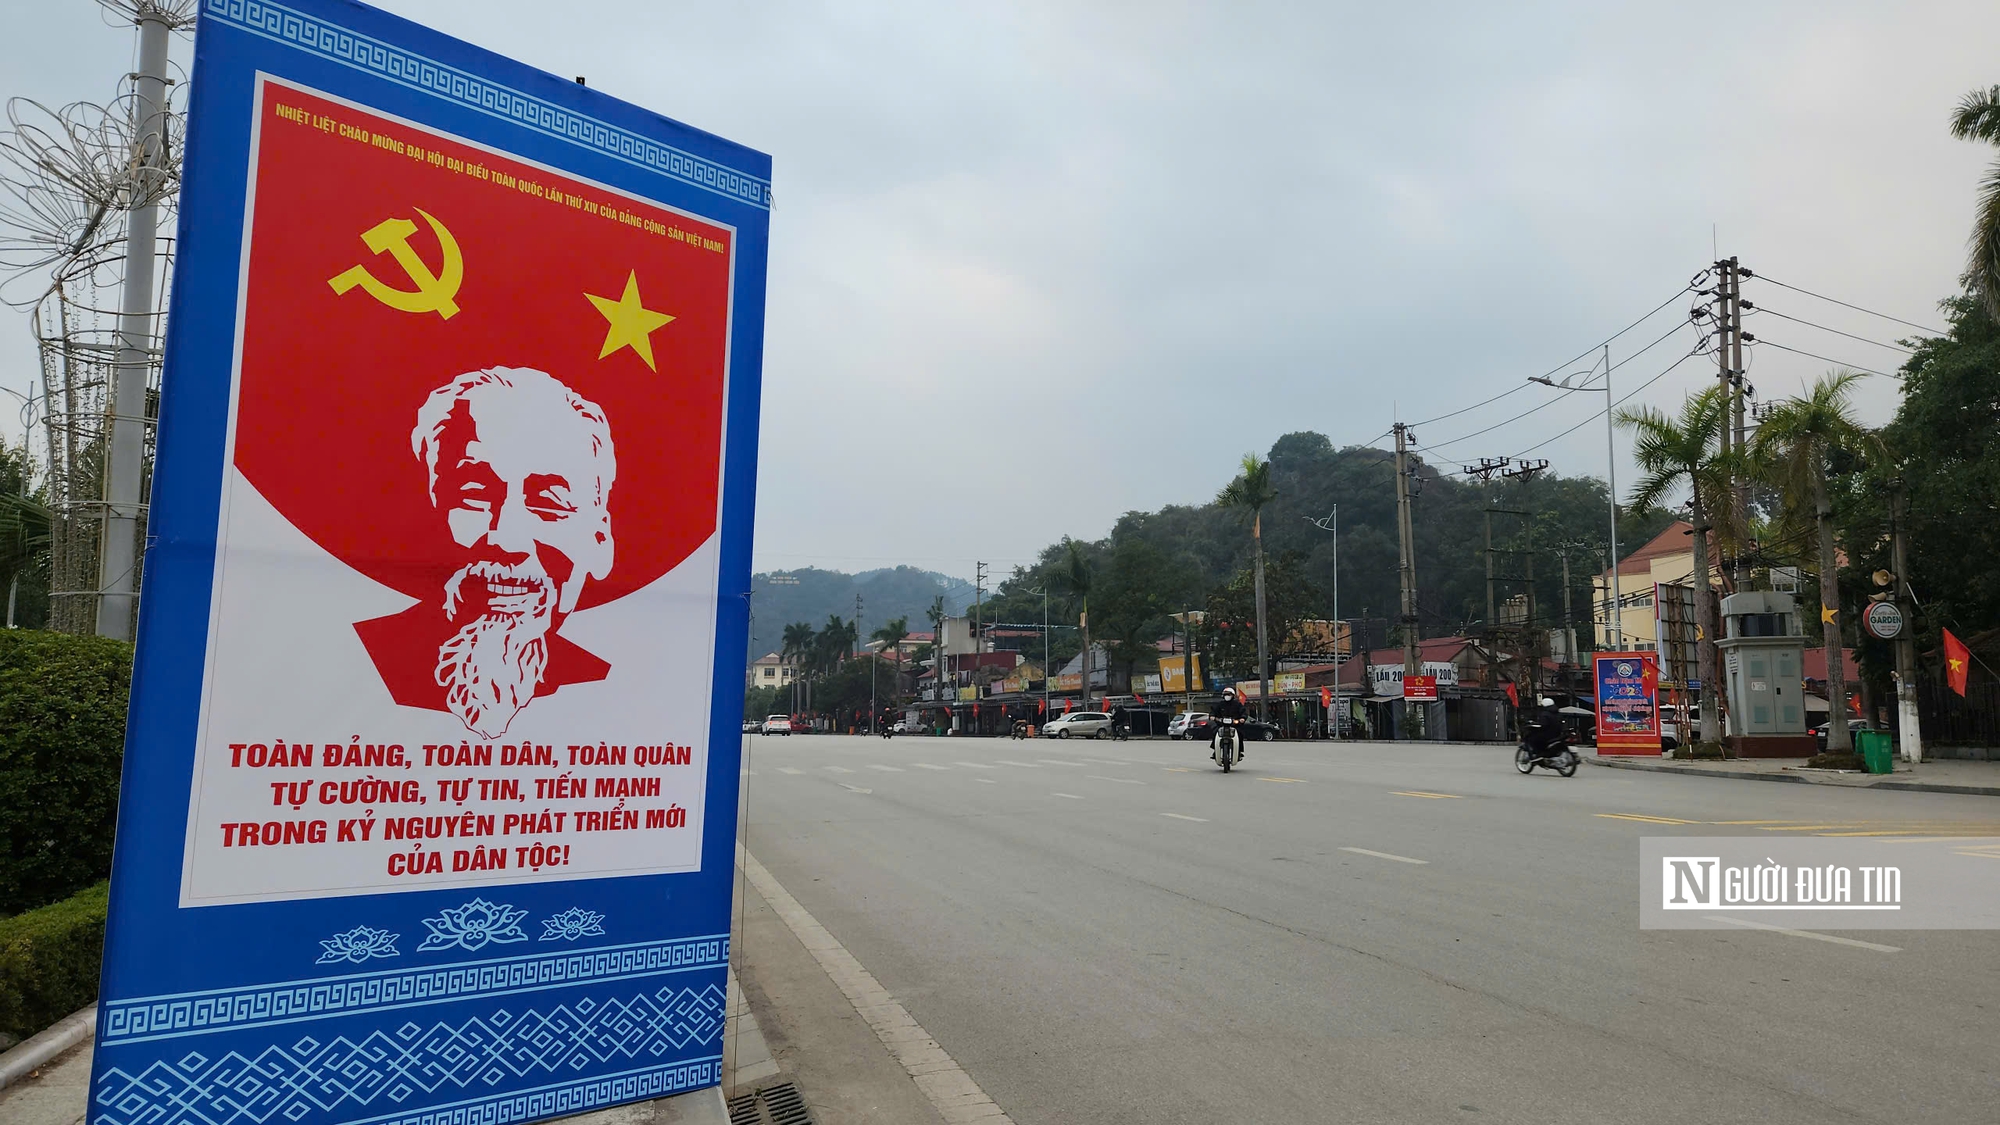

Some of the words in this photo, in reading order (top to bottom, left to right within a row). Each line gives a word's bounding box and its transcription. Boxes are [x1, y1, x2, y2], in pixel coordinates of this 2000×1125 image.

[275, 103, 309, 125] NHIỆT
[313, 115, 336, 133] LIỆT
[339, 123, 369, 143] CHÀO
[372, 133, 404, 154] MỪNG
[407, 144, 424, 162] ĐẠI
[427, 150, 444, 168] HỘI
[447, 157, 464, 174] ĐẠI
[466, 162, 489, 180] BIỂU
[491, 170, 516, 189] TOÀN
[518, 179, 543, 197] QUỐC
[545, 186, 563, 203] LẦN
[565, 194, 583, 209] THỨ
[584, 200, 598, 214] XIV
[600, 202, 617, 221] CỦA
[619, 209, 642, 228] ĐẢNG
[644, 219, 666, 236] CỘNG
[667, 224, 684, 241] SẢN
[686, 231, 702, 247] VIỆT
[703, 238, 724, 253] NAM!
[1870, 616, 1901, 624] GARDEN
[1440, 668, 1452, 680] 200
[228, 739, 313, 768] TOÀN
[322, 734, 412, 769] ĐẢNG,
[422, 740, 492, 767] TOÀN
[500, 740, 559, 769] DÂN,
[567, 741, 627, 766] TOÀN
[633, 741, 692, 767] QUÂN
[270, 779, 314, 811] TỰ
[318, 775, 427, 806] CƯỜNG,
[437, 777, 473, 806] TỰ
[478, 779, 525, 803] TIN,
[535, 771, 587, 799] TIẾN
[594, 777, 661, 802] MẠNH
[220, 820, 327, 847] TRONG
[337, 808, 376, 843] KỶ
[384, 811, 495, 840] NGUYÊN
[503, 808, 567, 836] PHÁT
[574, 802, 639, 832] TRIỂN
[645, 803, 686, 829] MỚI
[387, 843, 444, 877] CỦA
[452, 844, 507, 873] DÂN
[515, 841, 570, 872] TỘC!
